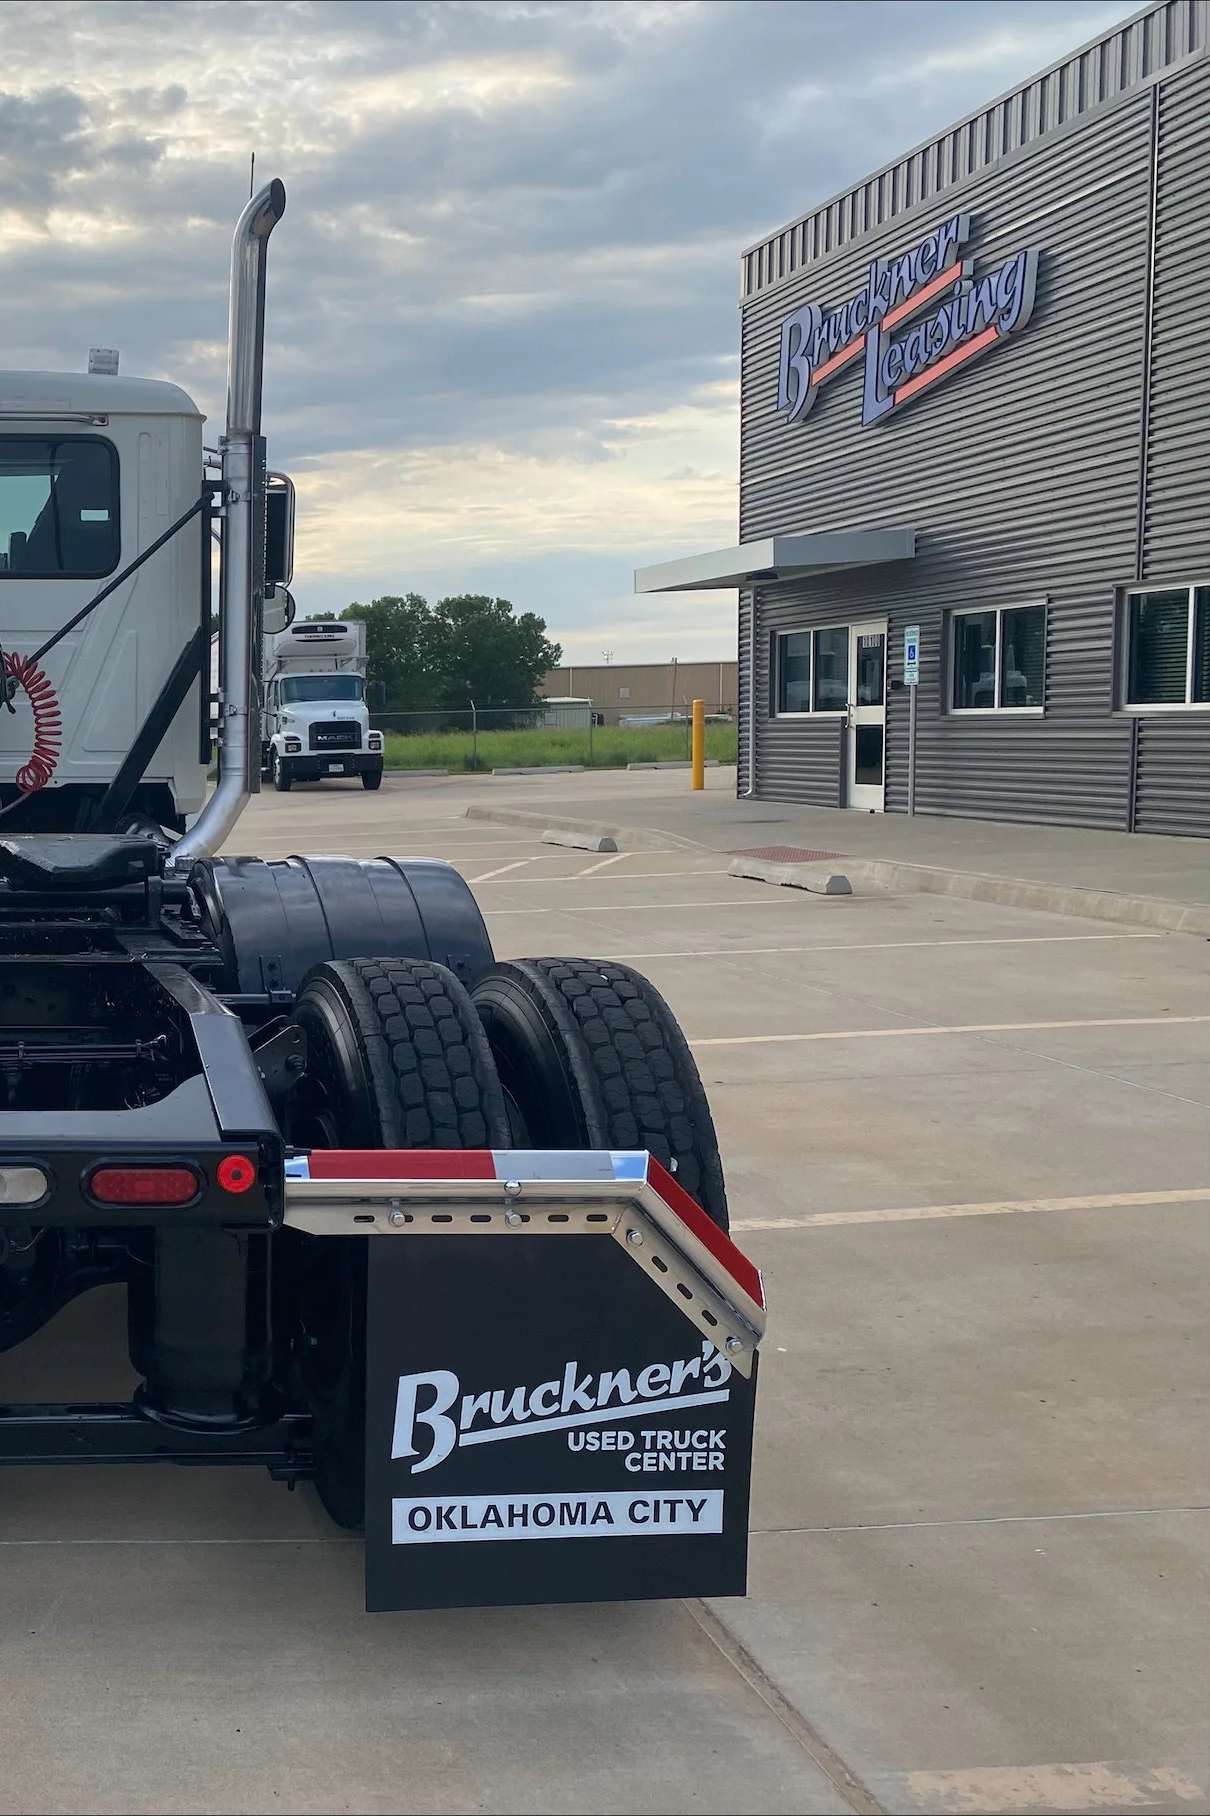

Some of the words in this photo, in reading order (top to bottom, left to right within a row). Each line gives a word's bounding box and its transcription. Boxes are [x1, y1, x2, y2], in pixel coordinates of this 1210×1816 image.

[776, 214, 965, 423] Bruckner
[861, 250, 1037, 427] Leasing
[390, 1340, 732, 1475] Bruckner's
[567, 1430, 635, 1452] USED
[640, 1429, 727, 1450] TRUCK
[624, 1452, 725, 1473] CENTER
[407, 1501, 615, 1532] OKLAHOMA
[628, 1498, 709, 1524] CITY
